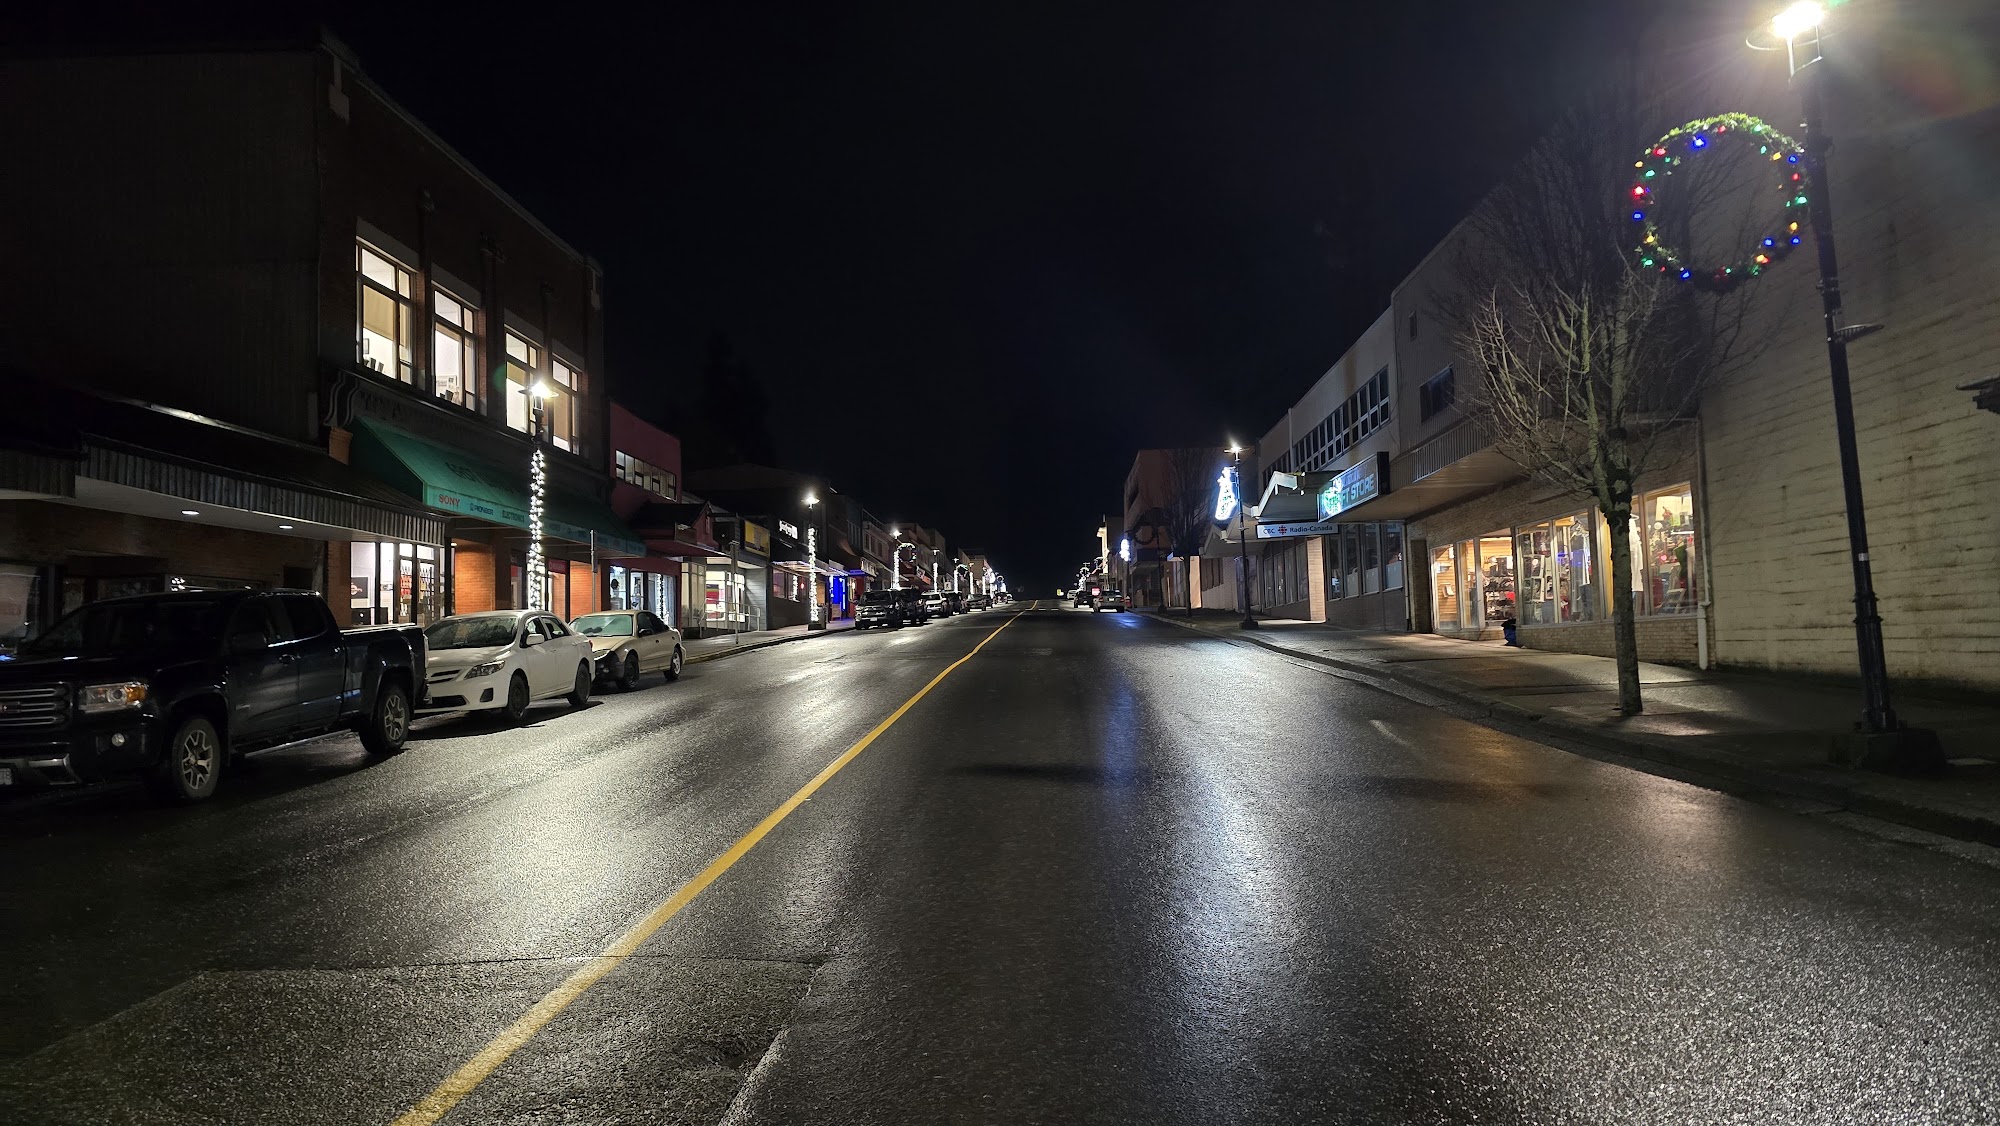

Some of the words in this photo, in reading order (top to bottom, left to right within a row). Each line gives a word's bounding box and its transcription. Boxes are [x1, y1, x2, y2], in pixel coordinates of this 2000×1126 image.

[1351, 474, 1374, 499] STORE
[439, 494, 460, 507] SONY
[1289, 525, 1333, 533] Radio-Canada
